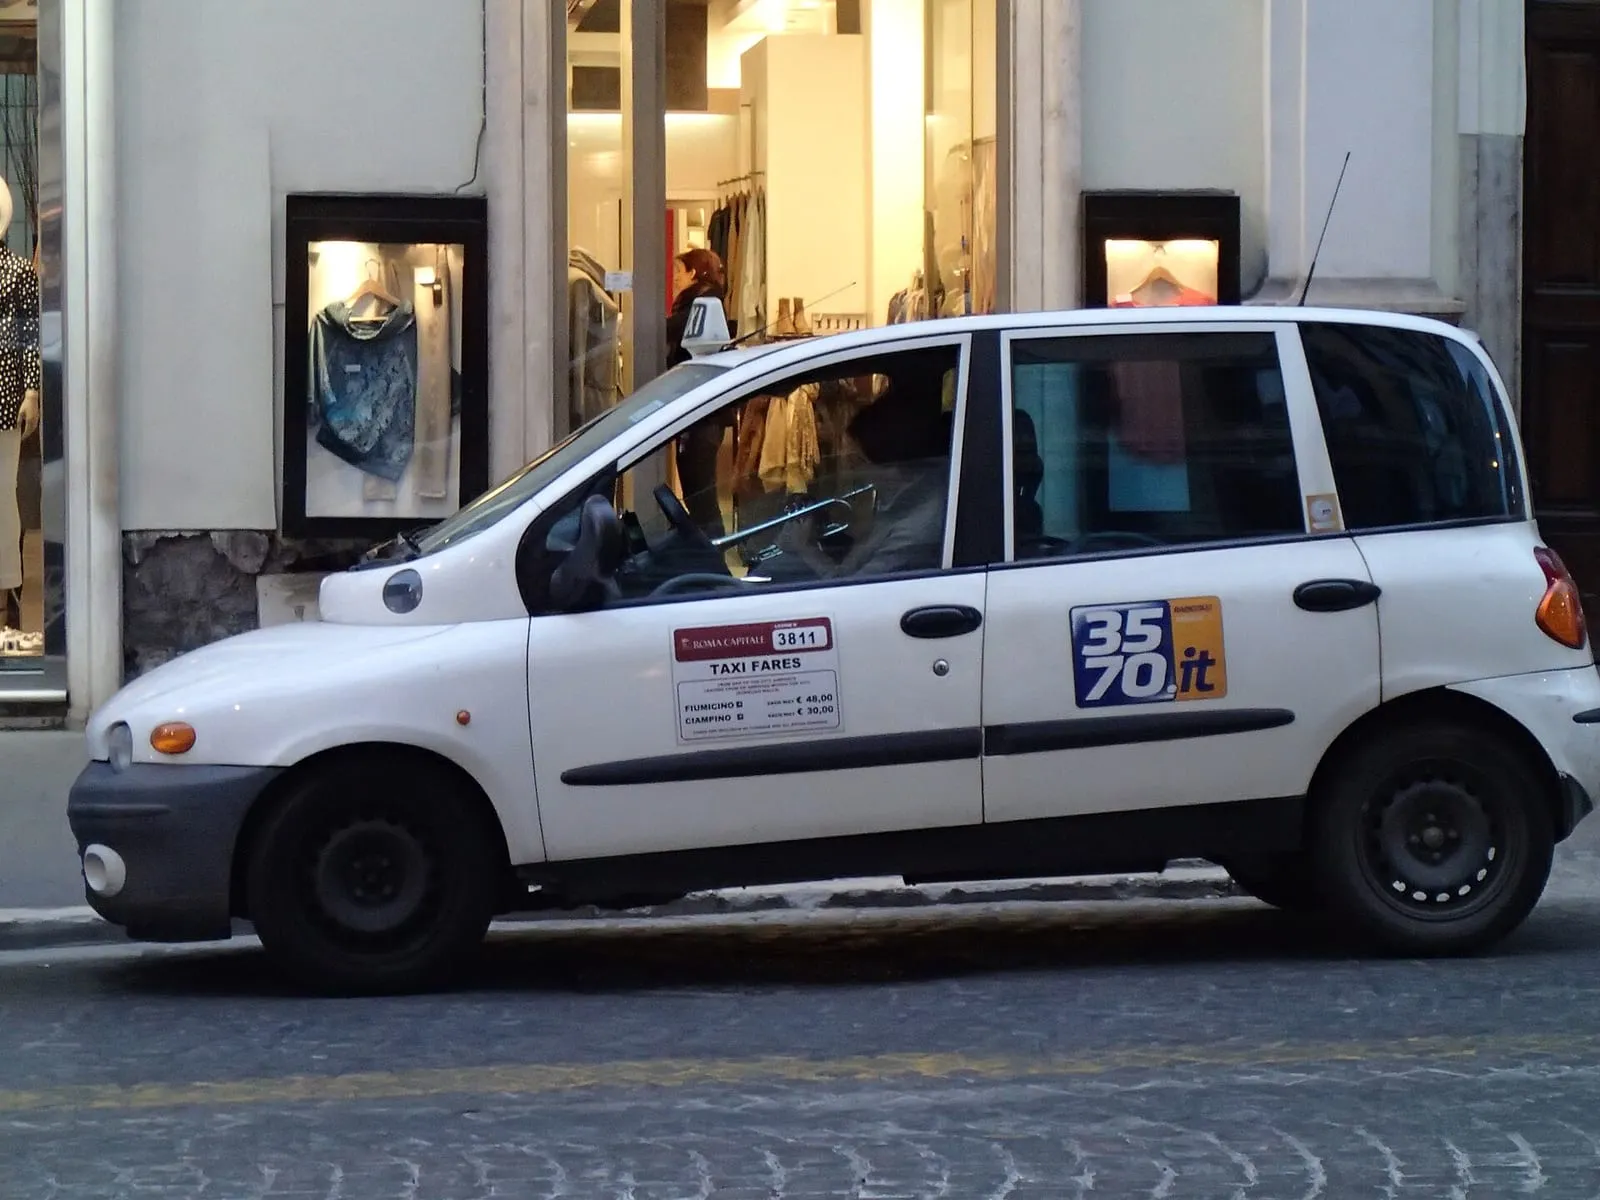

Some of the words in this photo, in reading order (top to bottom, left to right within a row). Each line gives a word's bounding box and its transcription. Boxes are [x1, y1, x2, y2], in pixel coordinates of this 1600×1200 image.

[693, 639, 722, 649] ROMA
[724, 635, 764, 647] CAPITALE
[778, 631, 816, 646] 3811
[1082, 607, 1164, 656] 35
[709, 662, 746, 675] TAXI
[751, 657, 801, 672] FARES
[684, 701, 735, 712] FIUMICINO
[806, 693, 833, 704] 48,00
[685, 714, 732, 725] CIAMPINO
[807, 705, 834, 715] 30,00
